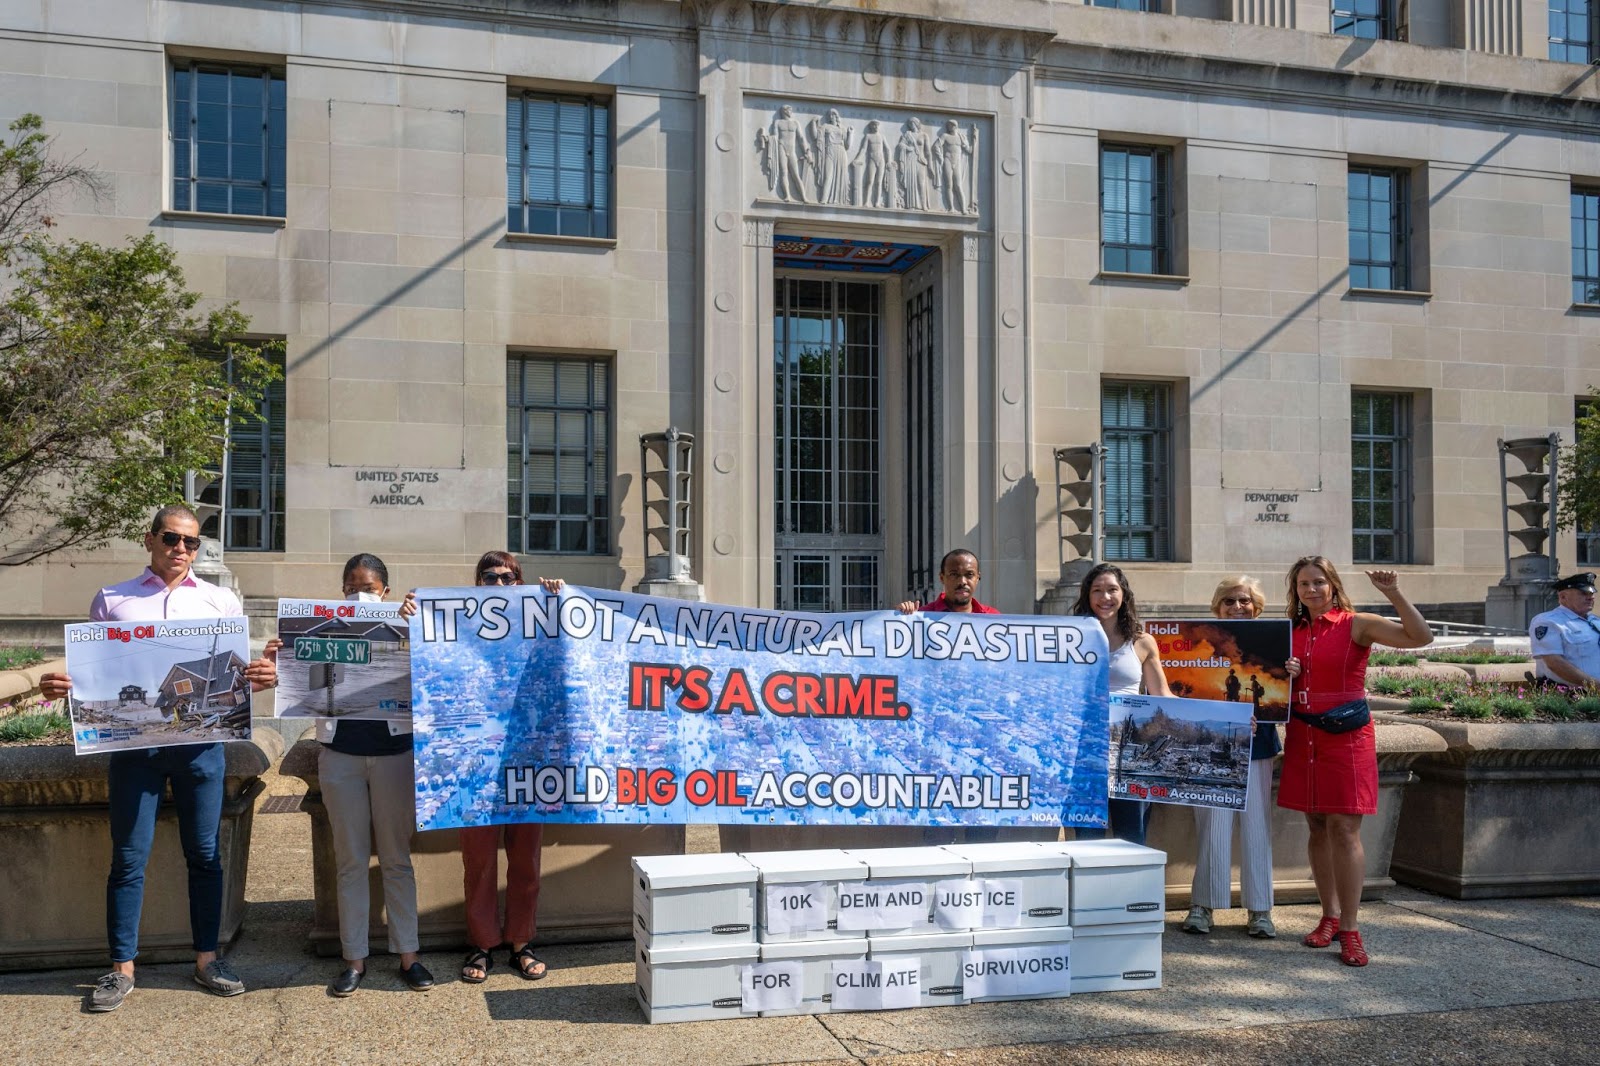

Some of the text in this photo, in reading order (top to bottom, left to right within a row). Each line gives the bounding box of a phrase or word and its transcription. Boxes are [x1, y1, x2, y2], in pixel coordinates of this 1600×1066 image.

[355, 471, 439, 483] UNITED STATES
[389, 483, 405, 493] OF
[370, 495, 424, 505] AMERICA
[1244, 493, 1299, 503] DEPARTMENT
[1266, 503, 1278, 512] OF
[1254, 513, 1290, 523] JUSTICE
[281, 604, 312, 616] Hold
[313, 605, 335, 620] Big
[337, 605, 355, 617] Oil
[71, 622, 243, 643] Hold Big Oil Accountable
[420, 596, 1098, 665] IT'S NOT A NATURAL DISASTER.
[1149, 623, 1179, 635] Hold
[298, 641, 365, 662] 25th St SW
[1158, 639, 1193, 654] ig Oil
[1160, 656, 1231, 668] ccountable
[628, 661, 913, 721] IT'S A CRIME.
[505, 765, 1031, 809] HOLD BIG OIL ACCOUNTABLE!
[1109, 782, 1242, 805] Hold Big Oil Accountable
[1031, 812, 1059, 822] NOAA
[1068, 813, 1098, 823] NOAA
[780, 893, 813, 910] 10K
[752, 973, 791, 990] FOR
[964, 956, 1070, 978] SURVIVORS!
